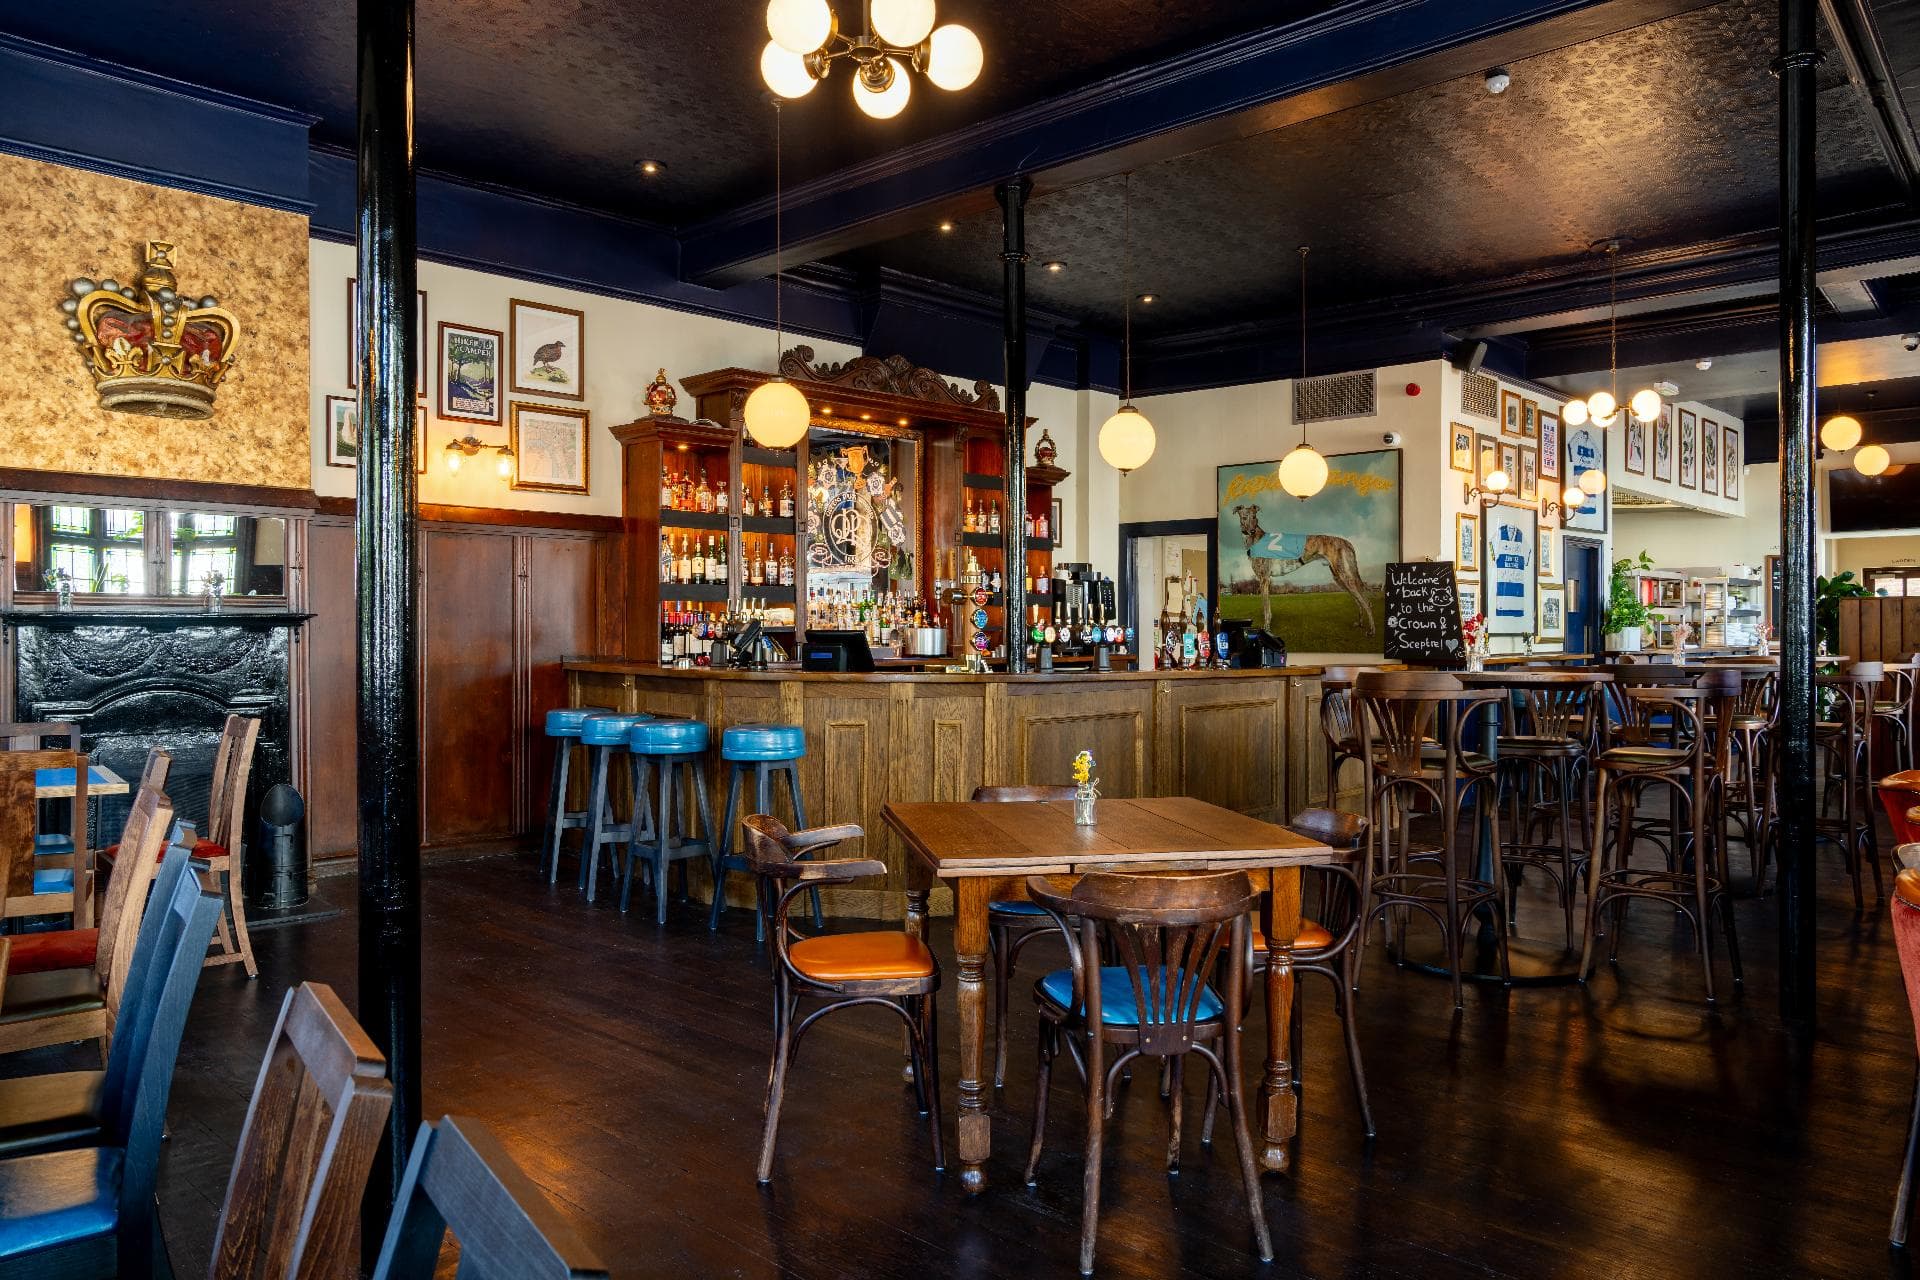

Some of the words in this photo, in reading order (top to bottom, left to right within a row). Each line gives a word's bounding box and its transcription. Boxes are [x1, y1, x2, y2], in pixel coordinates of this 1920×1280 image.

[1267, 532, 1284, 551] 2
[1391, 571, 1440, 586] Welcome
[1402, 586, 1429, 598] back
[1401, 603, 1413, 614] to
[1418, 602, 1436, 613] the
[1398, 617, 1437, 630] Crown
[1440, 616, 1448, 630] &
